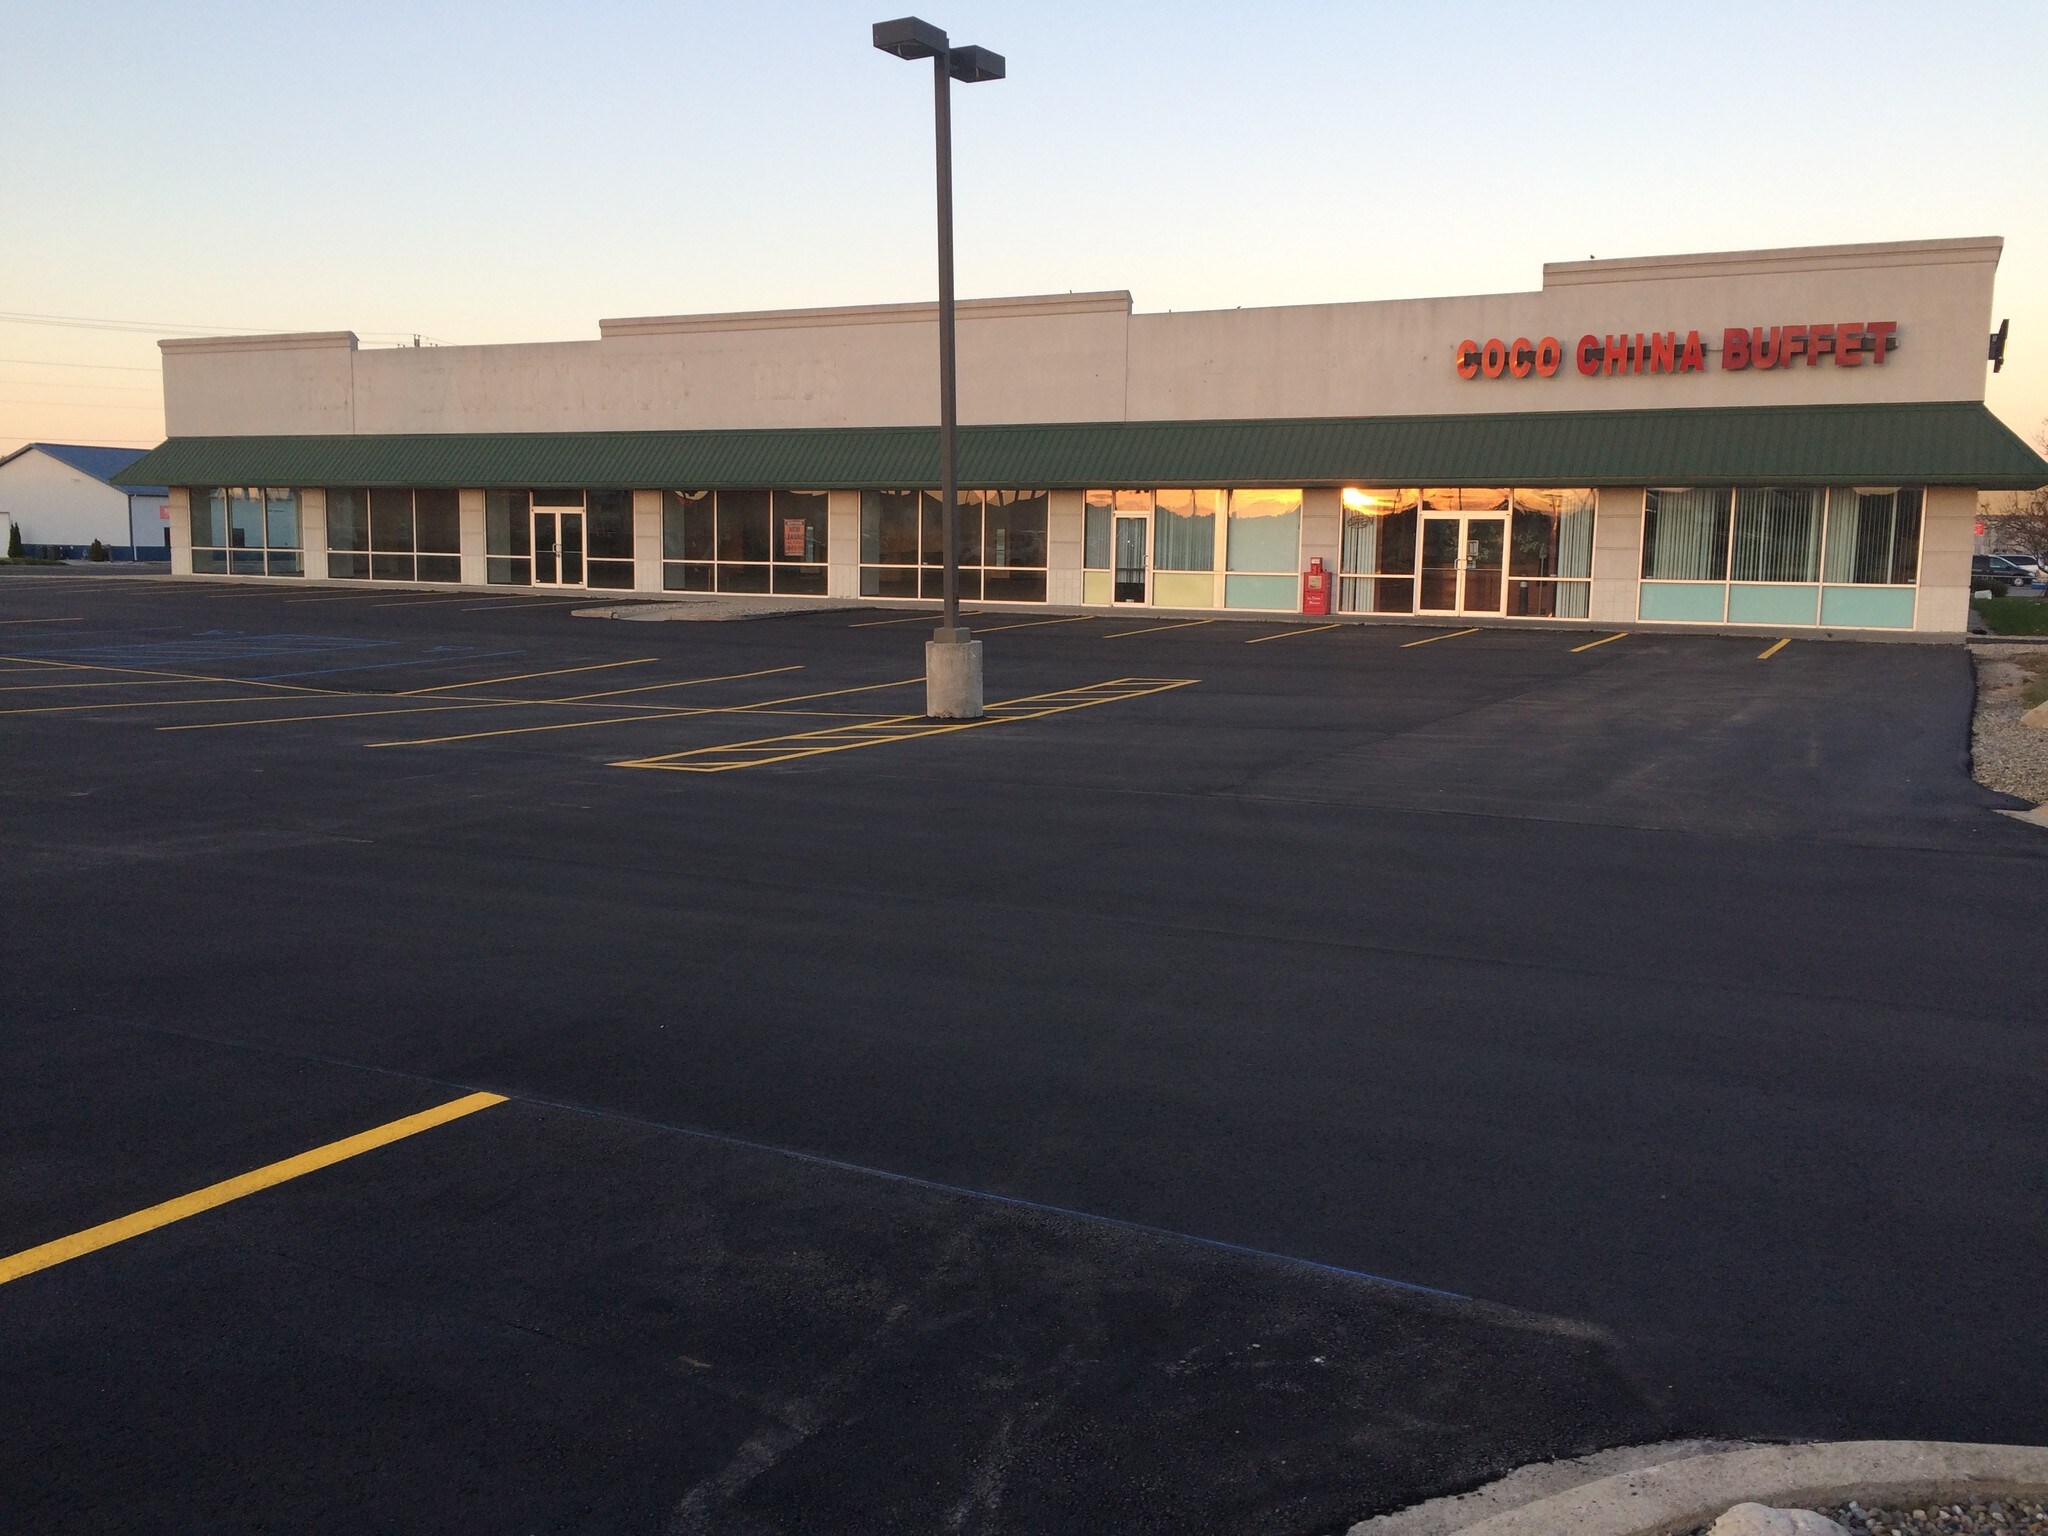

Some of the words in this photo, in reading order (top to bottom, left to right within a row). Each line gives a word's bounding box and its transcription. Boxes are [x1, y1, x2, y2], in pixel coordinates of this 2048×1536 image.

[1456, 336, 1561, 380] COCO
[1576, 330, 1705, 376] CHINA
[1721, 321, 1897, 370] BUFFET
